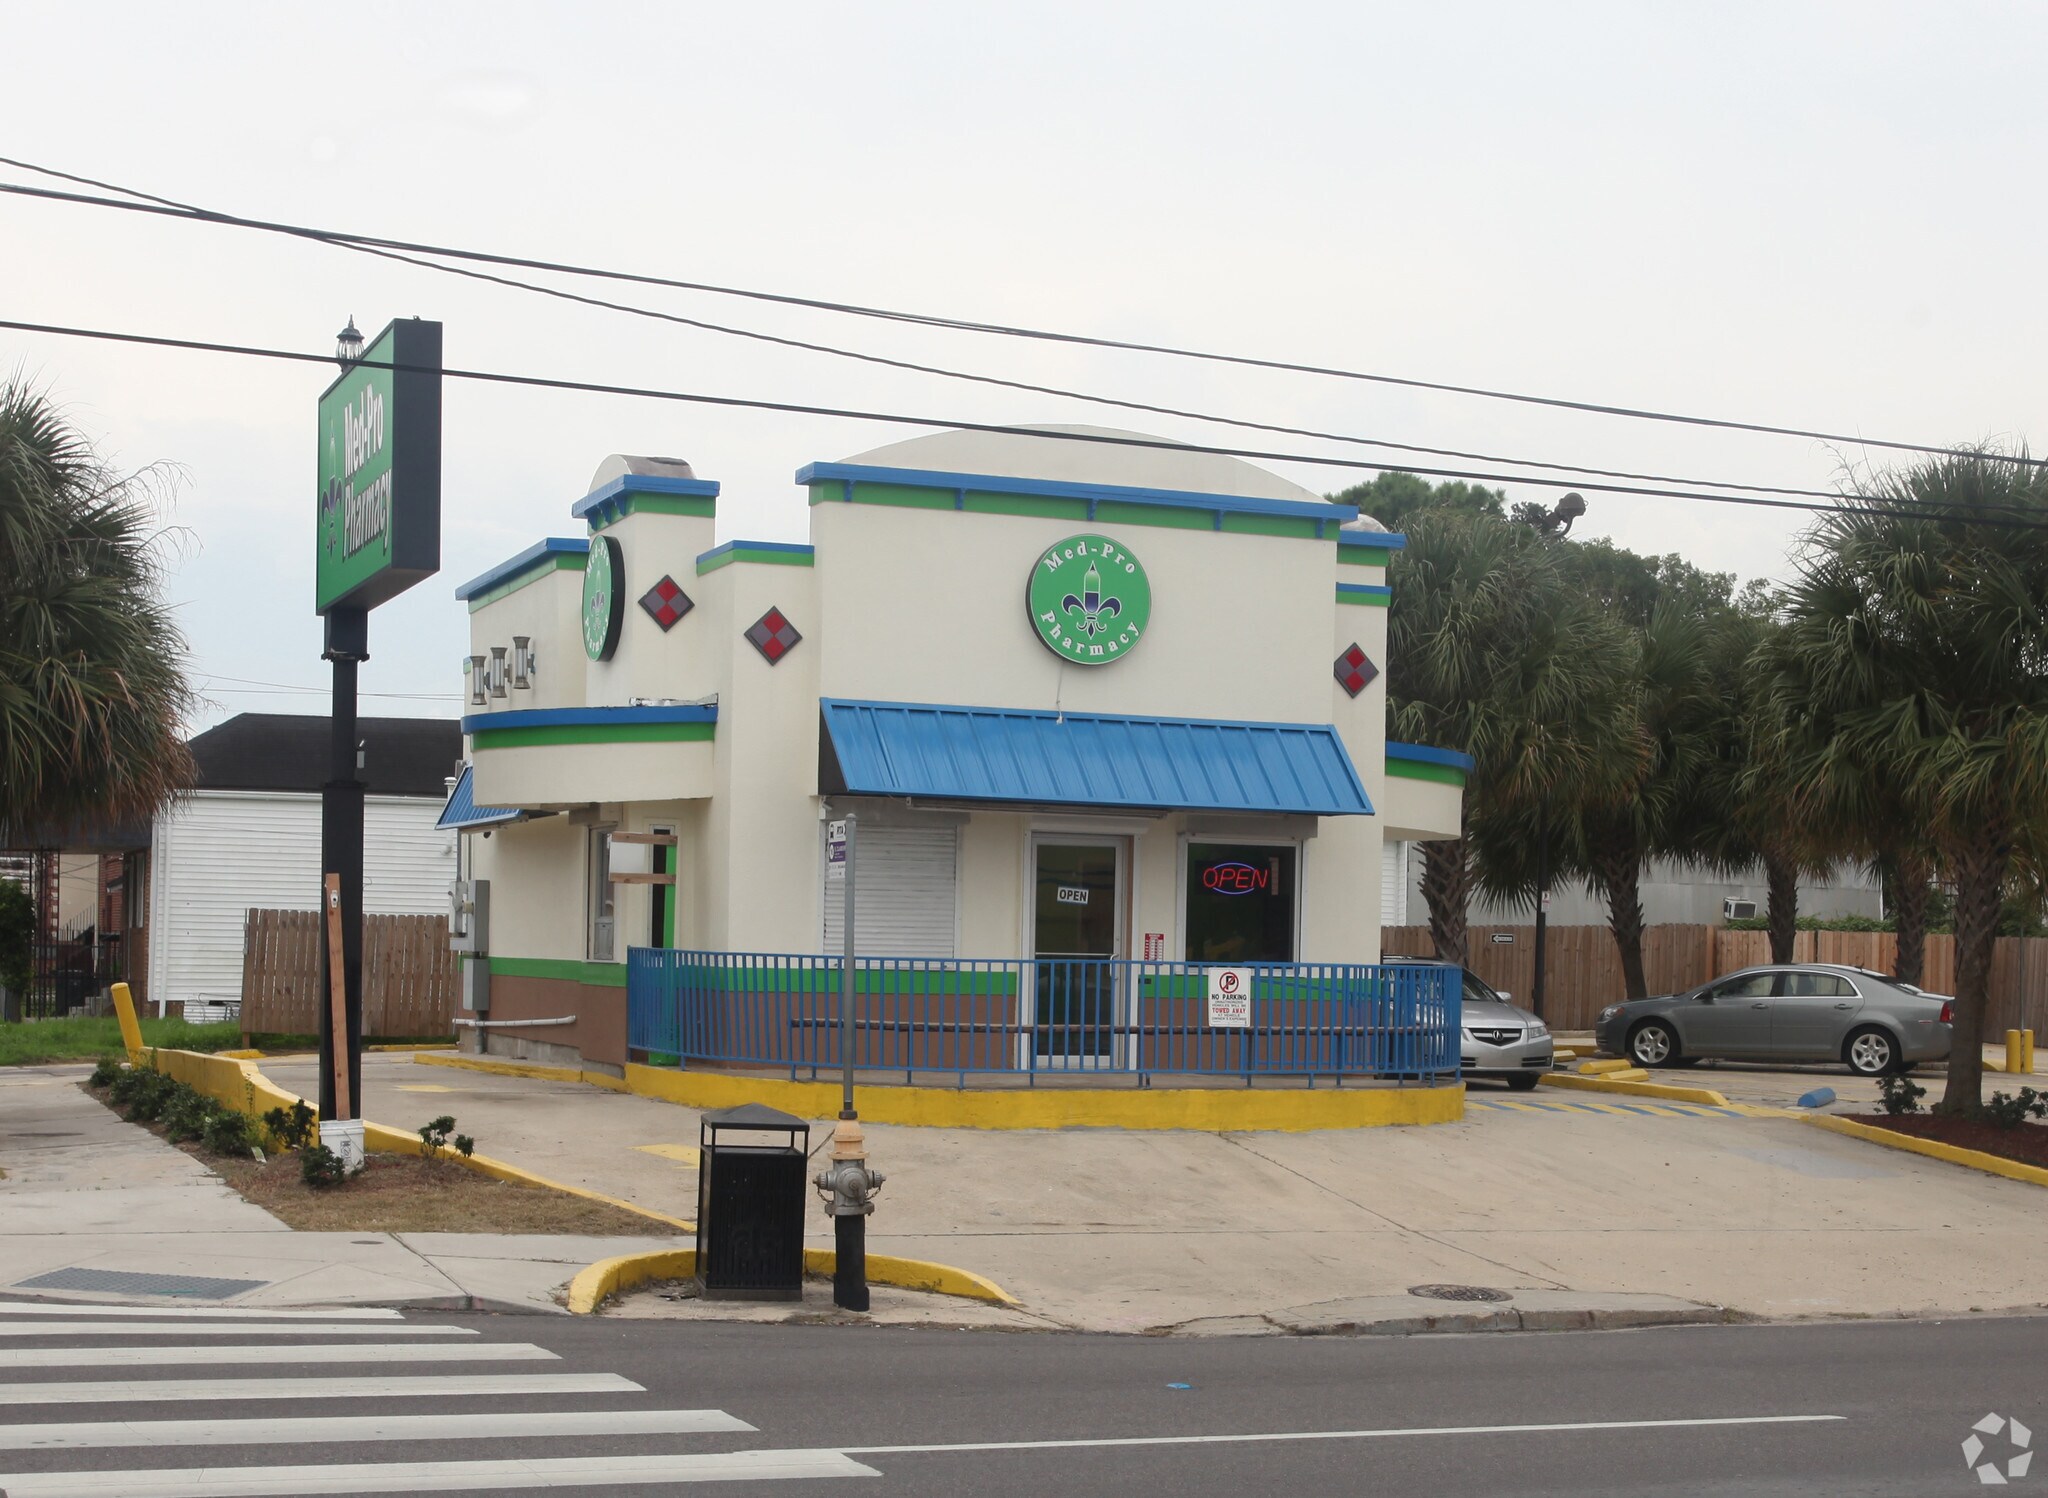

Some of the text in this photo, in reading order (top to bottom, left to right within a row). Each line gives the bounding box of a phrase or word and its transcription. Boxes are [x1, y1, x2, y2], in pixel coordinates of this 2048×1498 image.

[344, 383, 384, 478] Med-Pro
[343, 468, 392, 559] Pharmacy
[1043, 541, 1135, 573] Med-Pro
[1040, 610, 1139, 656] Pharmacy
[1059, 889, 1087, 902] OPEN
[1203, 868, 1269, 889] OPEN
